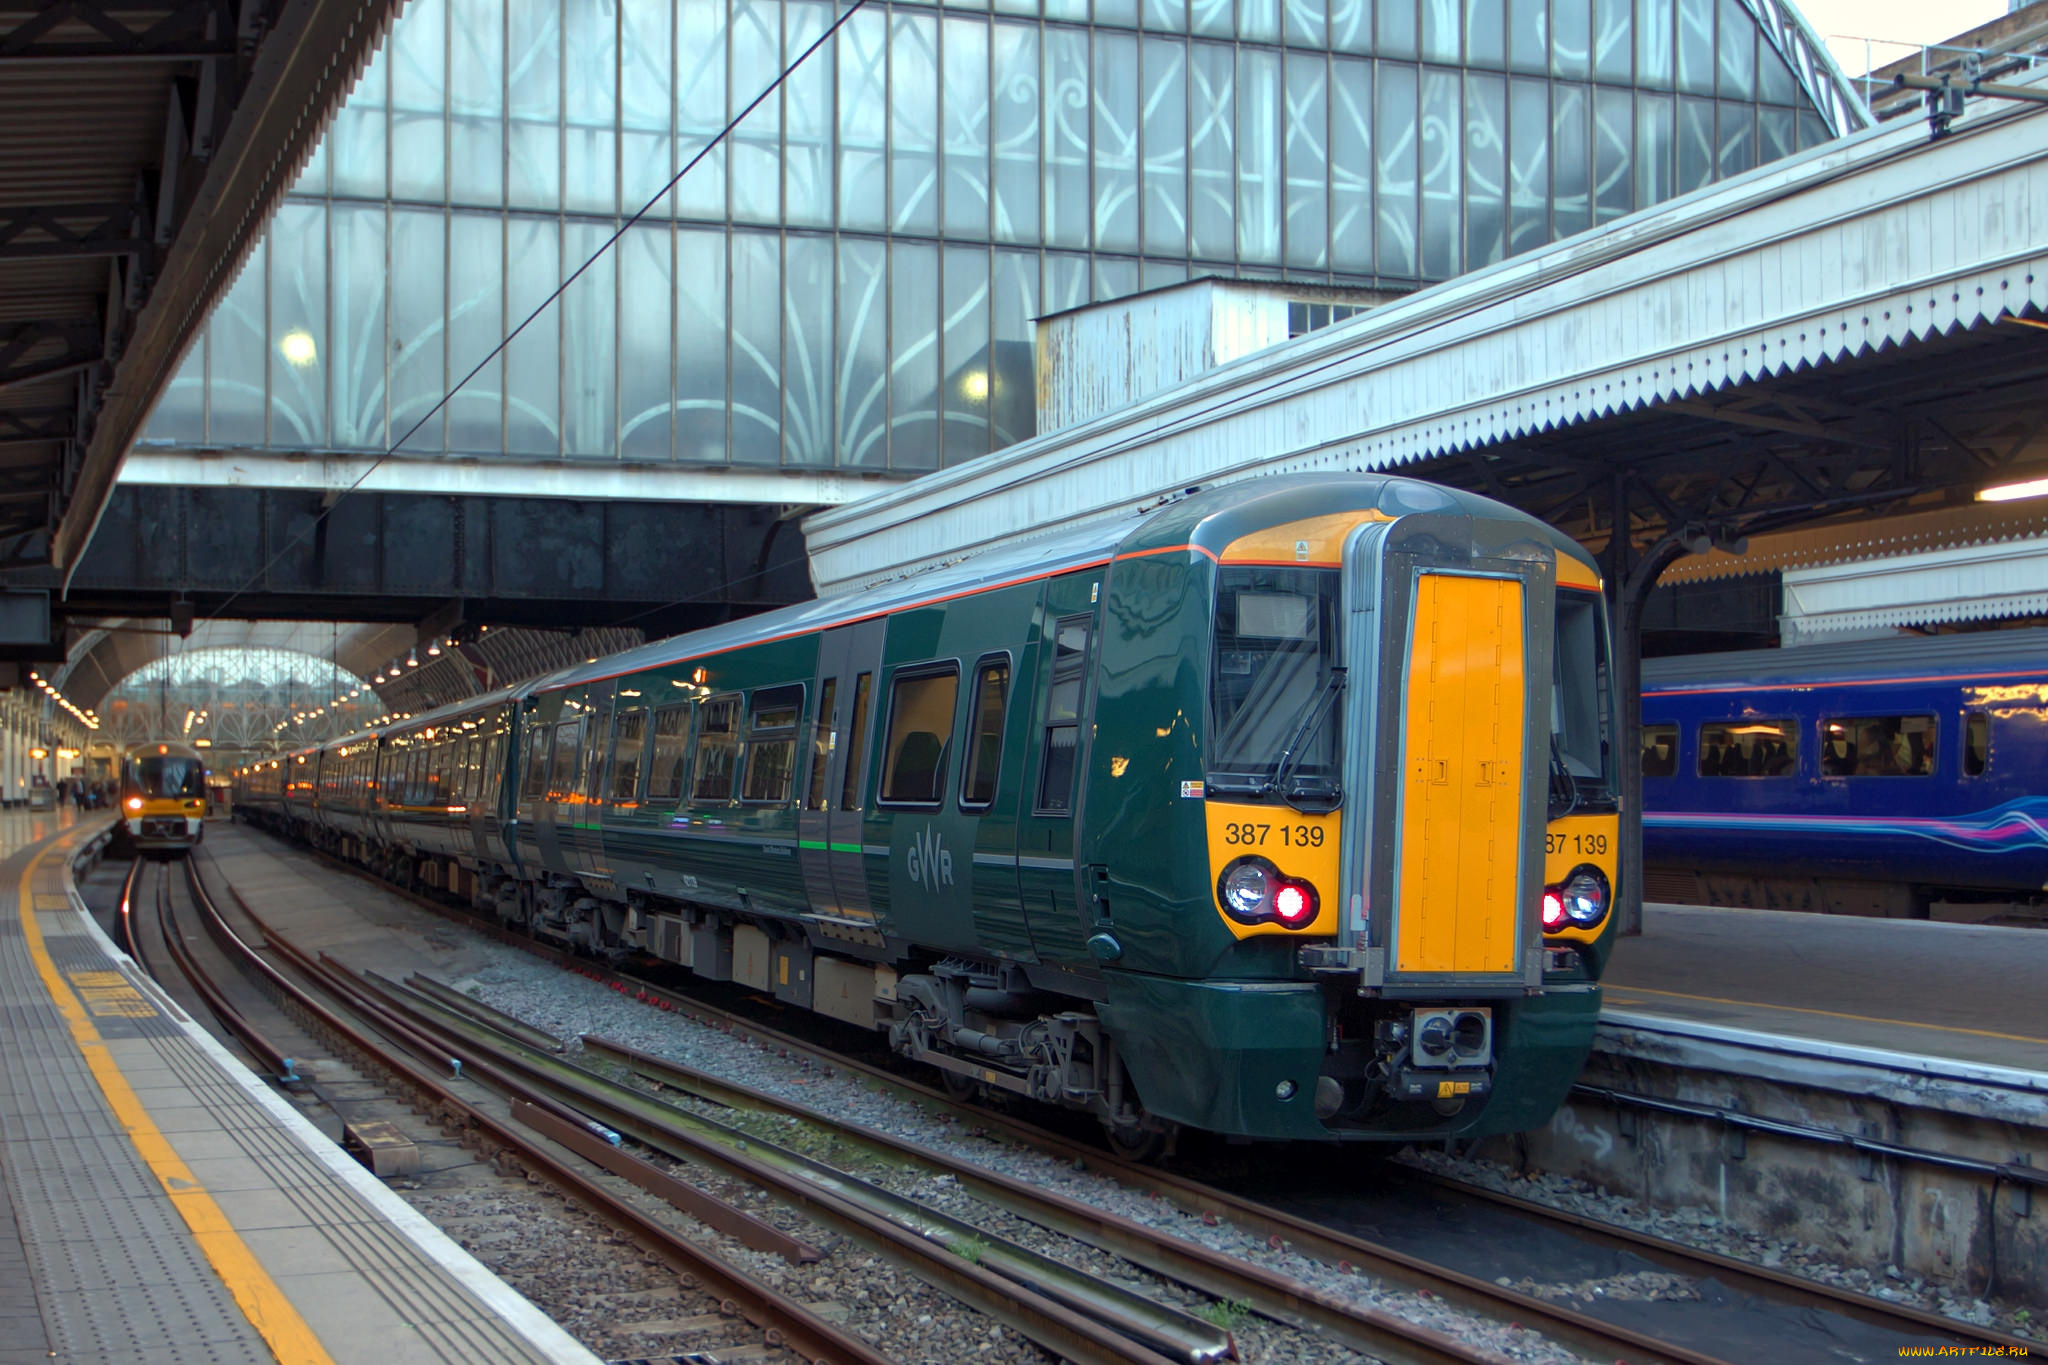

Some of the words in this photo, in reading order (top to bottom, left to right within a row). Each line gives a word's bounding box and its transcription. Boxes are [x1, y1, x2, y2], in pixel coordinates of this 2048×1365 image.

[1225, 823, 1271, 845] 387
[1280, 825, 1325, 847] 139
[1545, 833, 1567, 854] 87
[1573, 834, 1607, 855] 139
[907, 821, 954, 894] GWR
